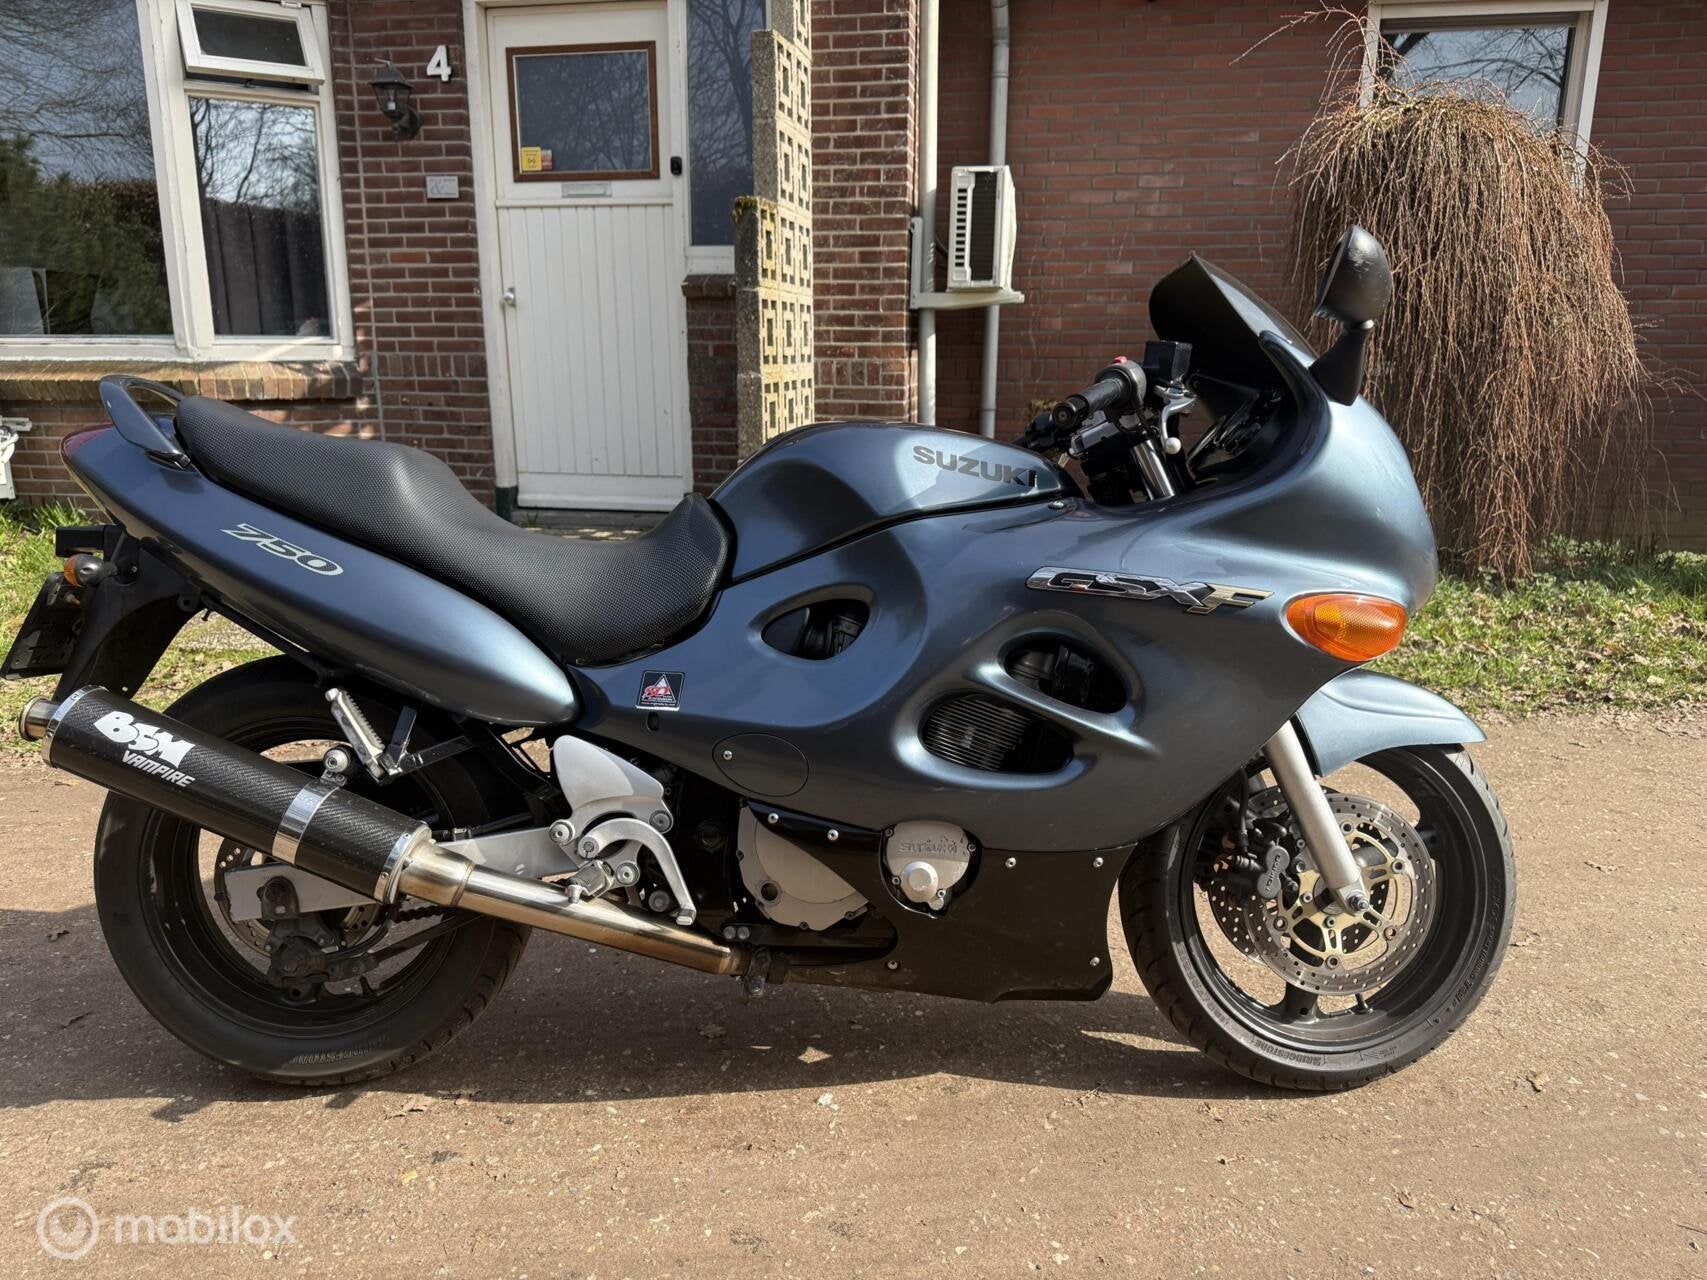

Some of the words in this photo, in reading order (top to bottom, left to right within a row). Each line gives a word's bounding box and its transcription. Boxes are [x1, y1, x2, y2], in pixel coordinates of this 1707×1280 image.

[426, 45, 451, 81] 4
[912, 445, 1037, 487] SUZUKI
[220, 523, 344, 576] 750
[93, 710, 196, 768] BSM
[122, 750, 196, 788] VAMPIRE
[1254, 1039, 1323, 1067] BRIDGESTONE
